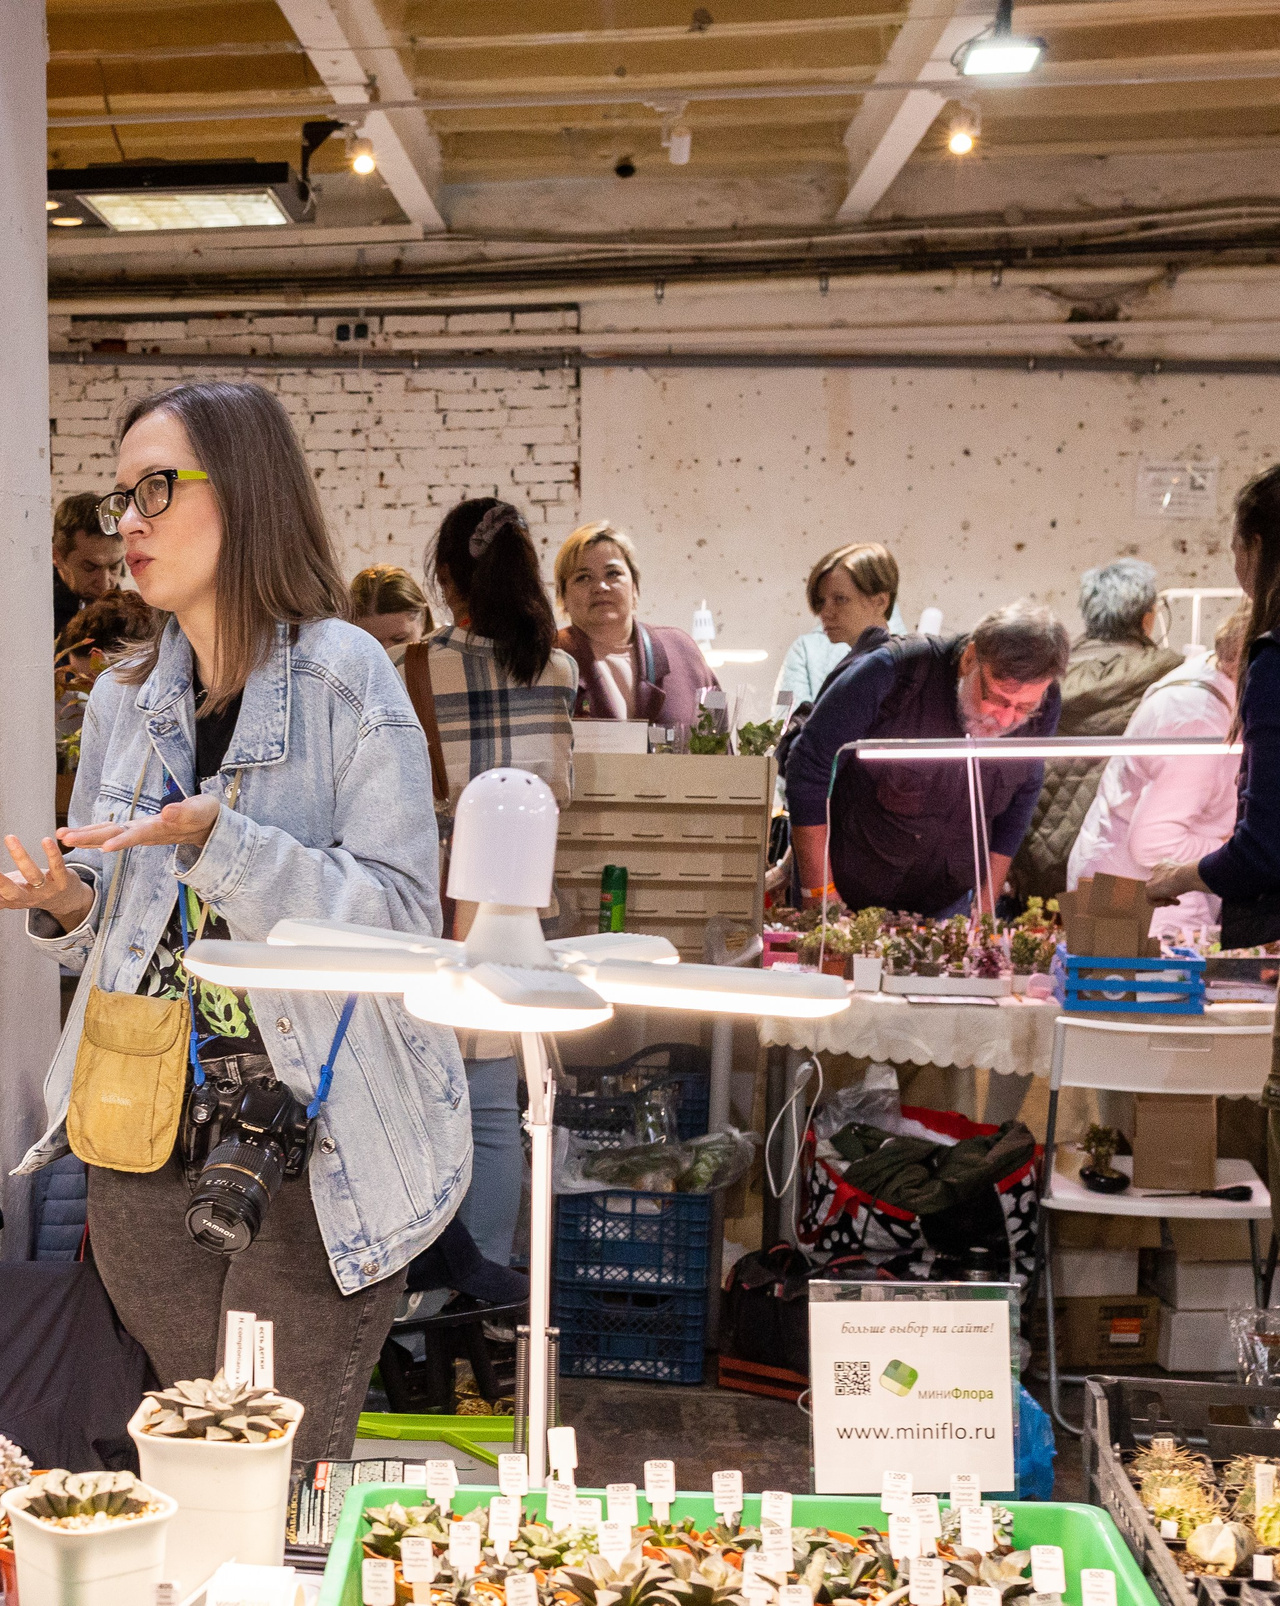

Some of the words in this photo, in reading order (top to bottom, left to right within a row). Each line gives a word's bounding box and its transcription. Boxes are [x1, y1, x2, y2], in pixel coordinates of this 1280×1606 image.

[241, 1122, 264, 1134] Canon
[201, 1218, 236, 1239] TAMRON
[889, 1321, 928, 1338] выбор
[932, 1325, 948, 1334] на
[951, 1322, 994, 1334] сайте!
[918, 1387, 994, 1402] миниФлора
[836, 1422, 996, 1440] www.miniflo.ru
[957, 1474, 971, 1482] 900
[554, 1483, 570, 1491] 1000
